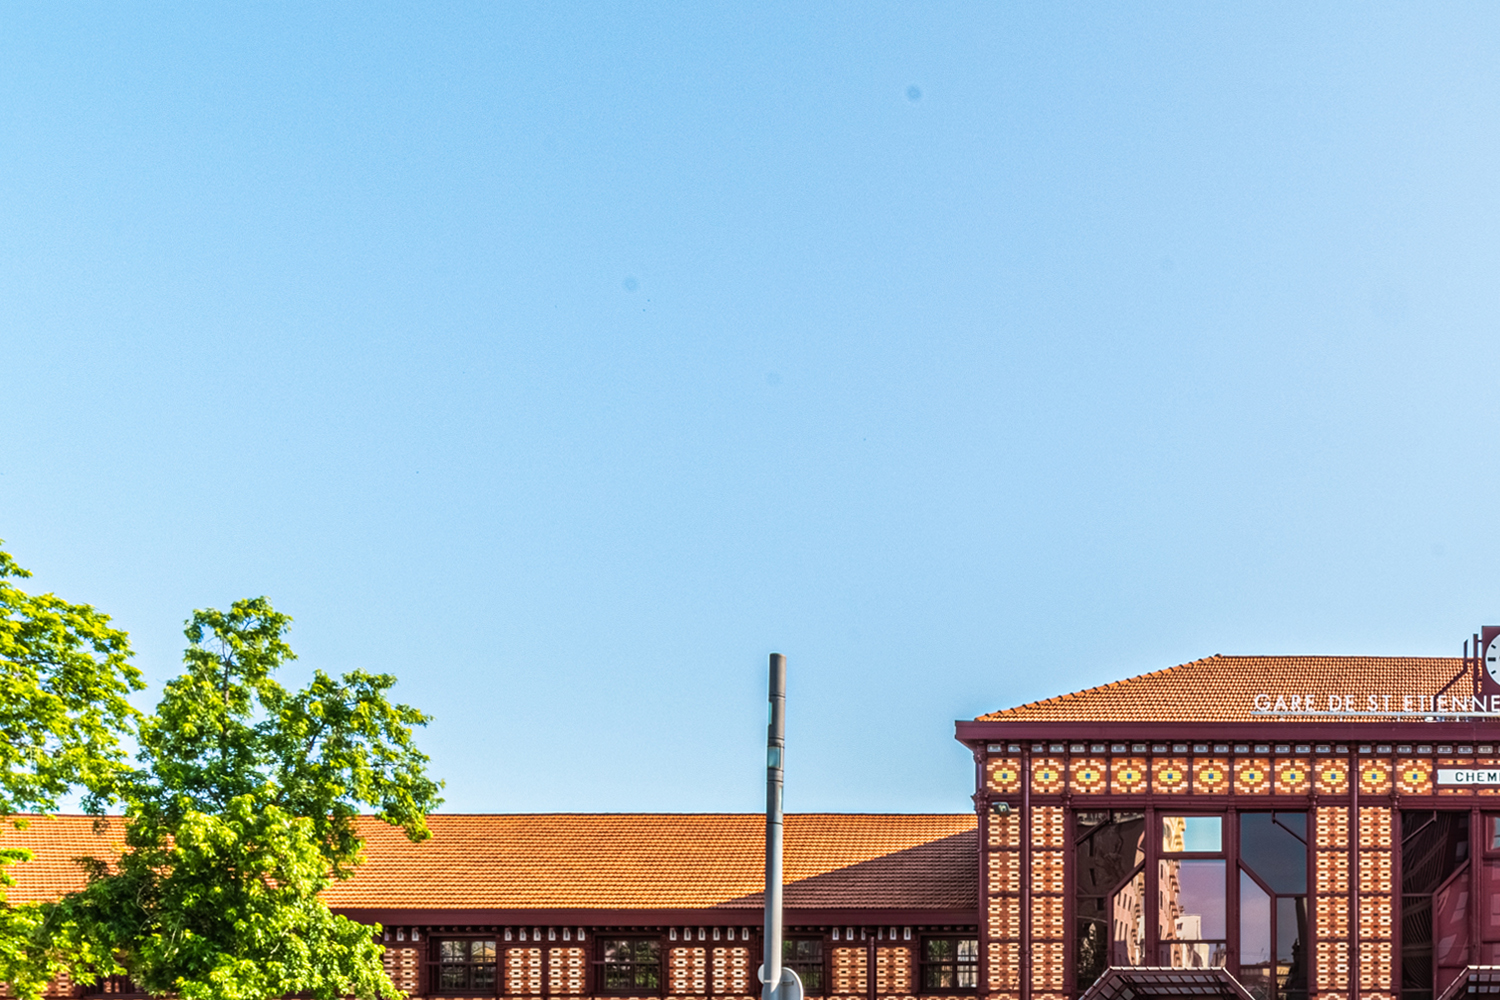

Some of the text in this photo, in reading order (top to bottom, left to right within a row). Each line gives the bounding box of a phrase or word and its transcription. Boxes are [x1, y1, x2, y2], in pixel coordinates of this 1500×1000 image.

[1254, 694, 1315, 713] GARE
[1330, 695, 1355, 713] DE
[1367, 695, 1392, 713] ST
[1404, 695, 1500, 713] ETIENNE
